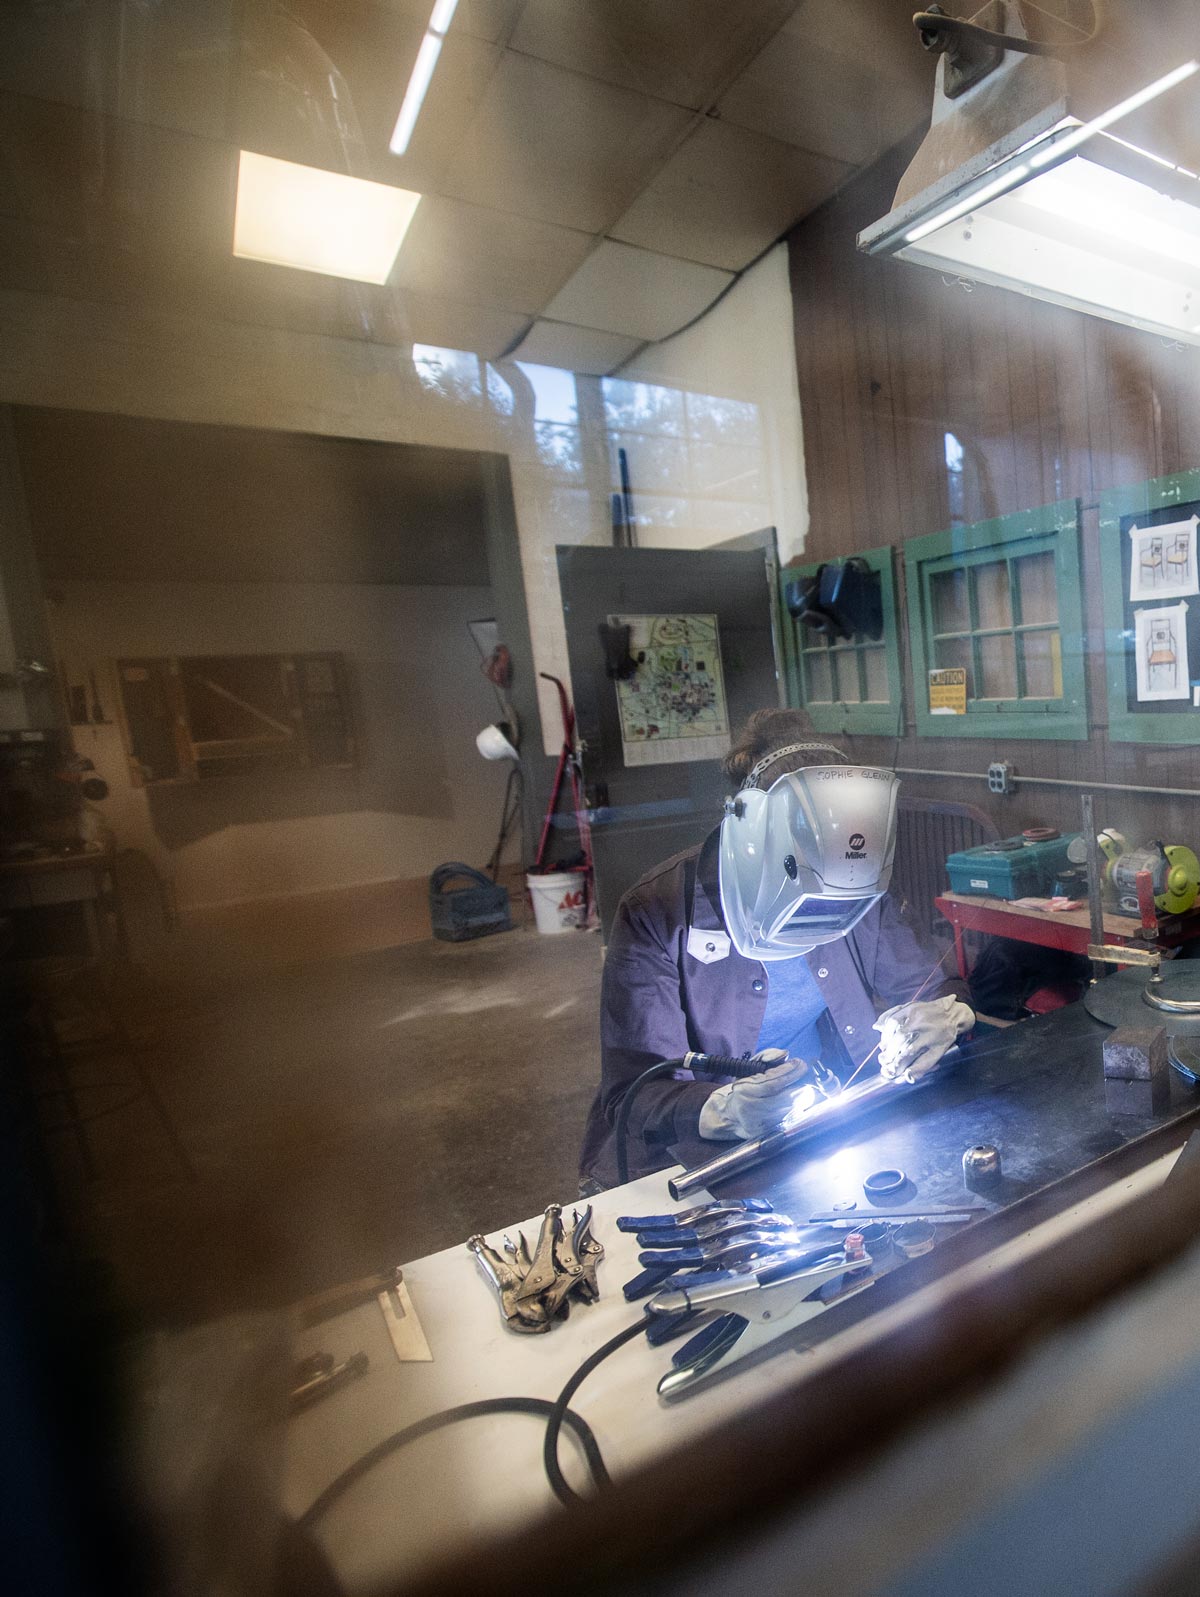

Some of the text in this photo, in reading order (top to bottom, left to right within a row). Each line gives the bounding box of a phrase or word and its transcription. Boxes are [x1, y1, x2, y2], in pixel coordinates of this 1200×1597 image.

[930, 672, 963, 685] CAUTION
[816, 770, 853, 781] SOPHIE
[845, 851, 867, 860] Miller
